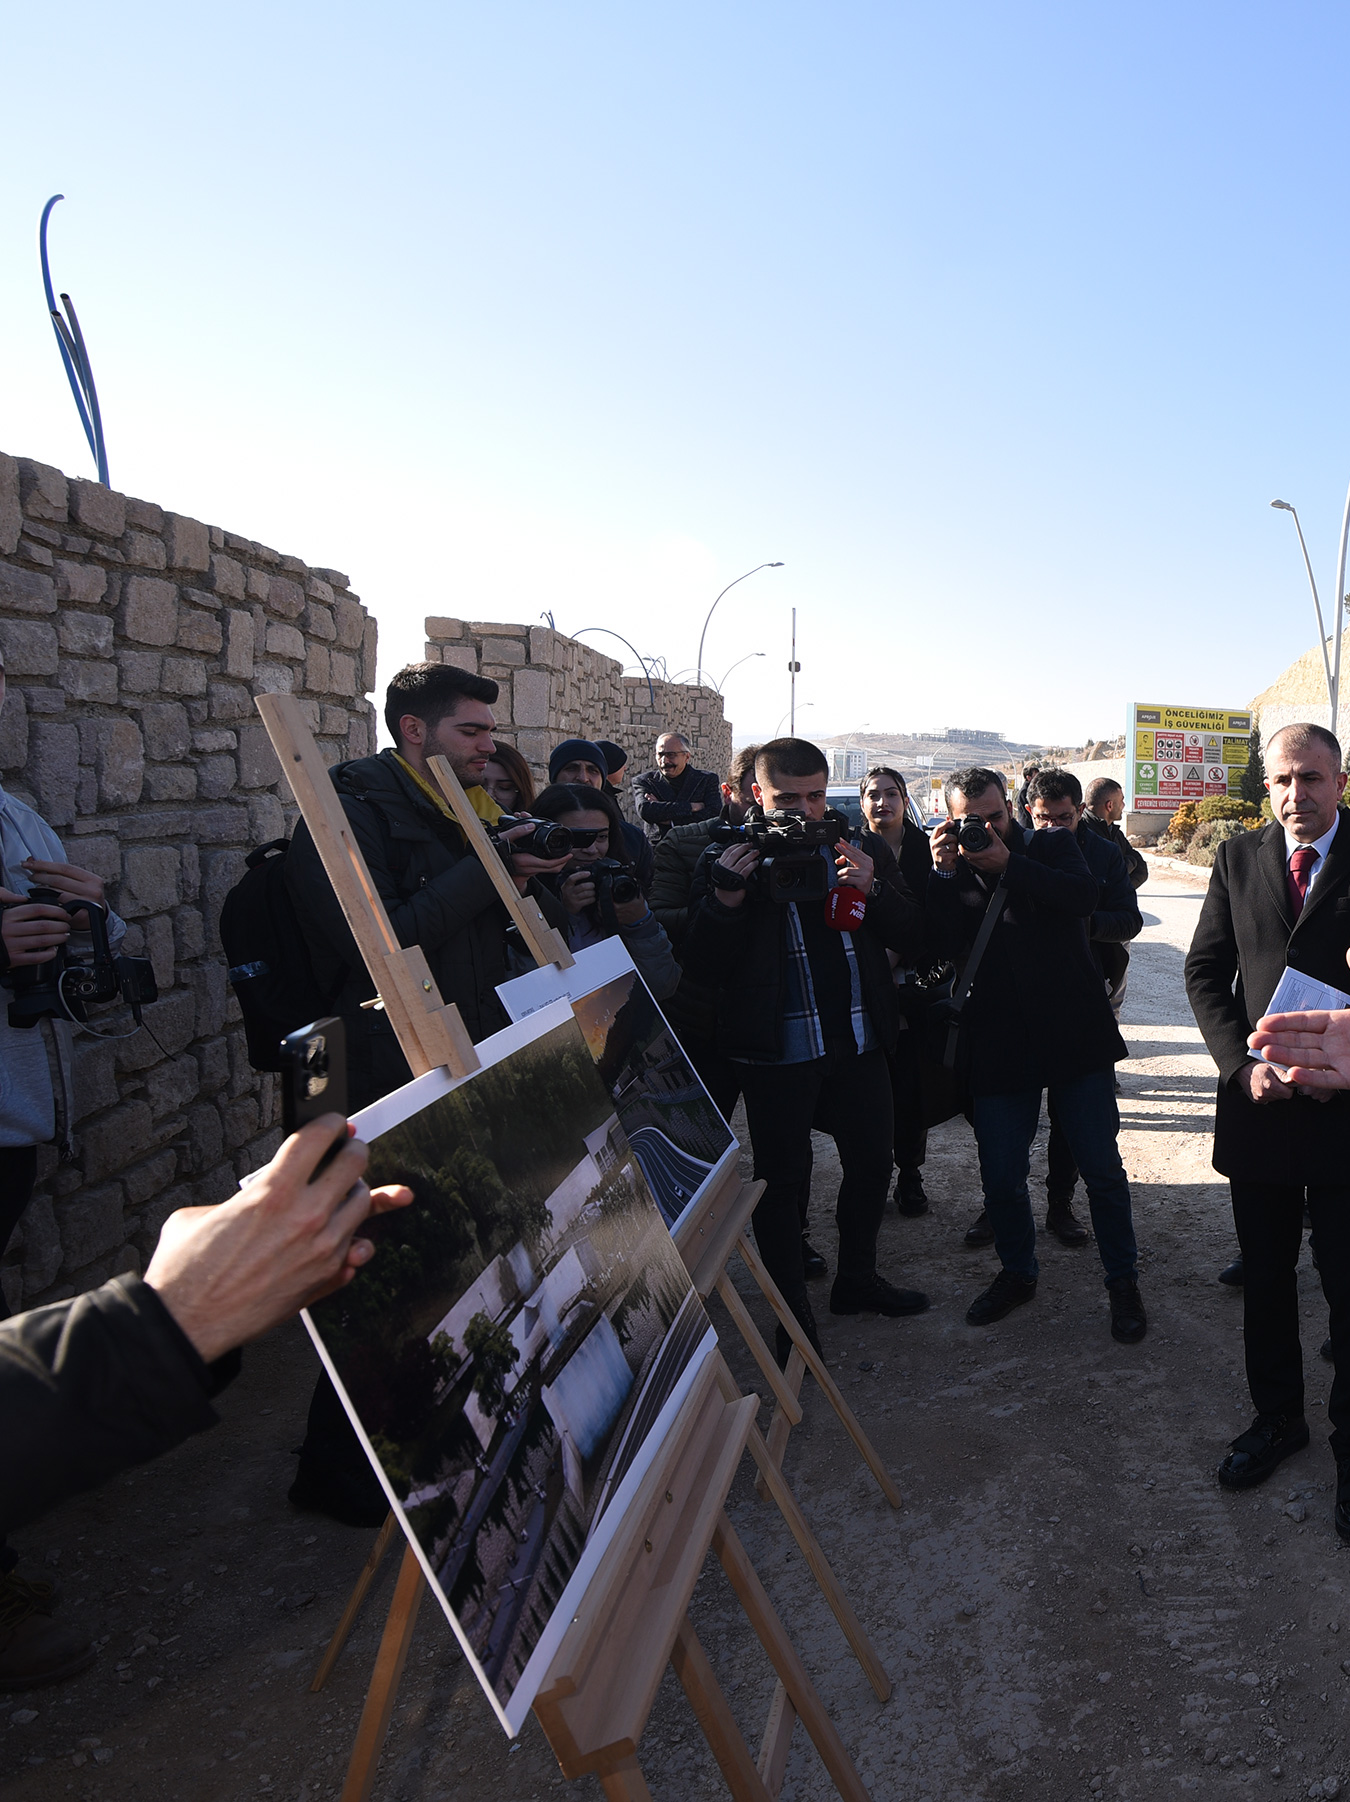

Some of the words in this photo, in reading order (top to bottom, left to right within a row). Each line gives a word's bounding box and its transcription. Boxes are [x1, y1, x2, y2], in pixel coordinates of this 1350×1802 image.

[1165, 709, 1224, 720] ÖNCELİĞİMİZ
[1164, 719, 1173, 729] İŞ
[1176, 720, 1225, 731] GÜVENLİĞİ
